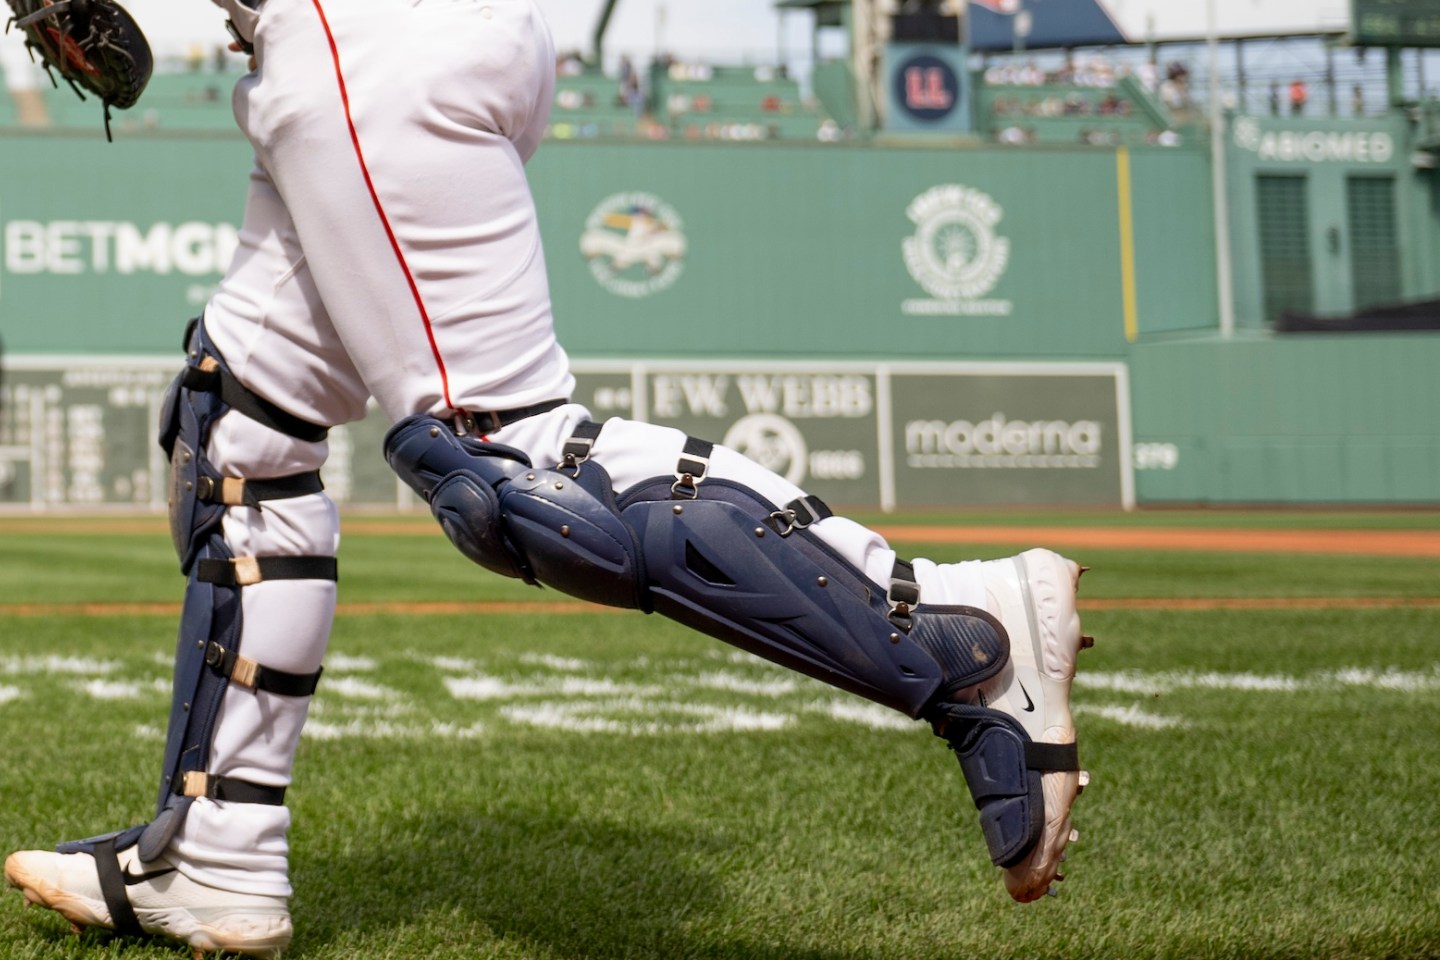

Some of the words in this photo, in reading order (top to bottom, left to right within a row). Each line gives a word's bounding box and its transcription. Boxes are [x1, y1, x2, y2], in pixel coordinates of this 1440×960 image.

[1257, 129, 1395, 163] ABIOMED
[735, 376, 872, 418] WEBB
[906, 411, 1101, 456] moderna
